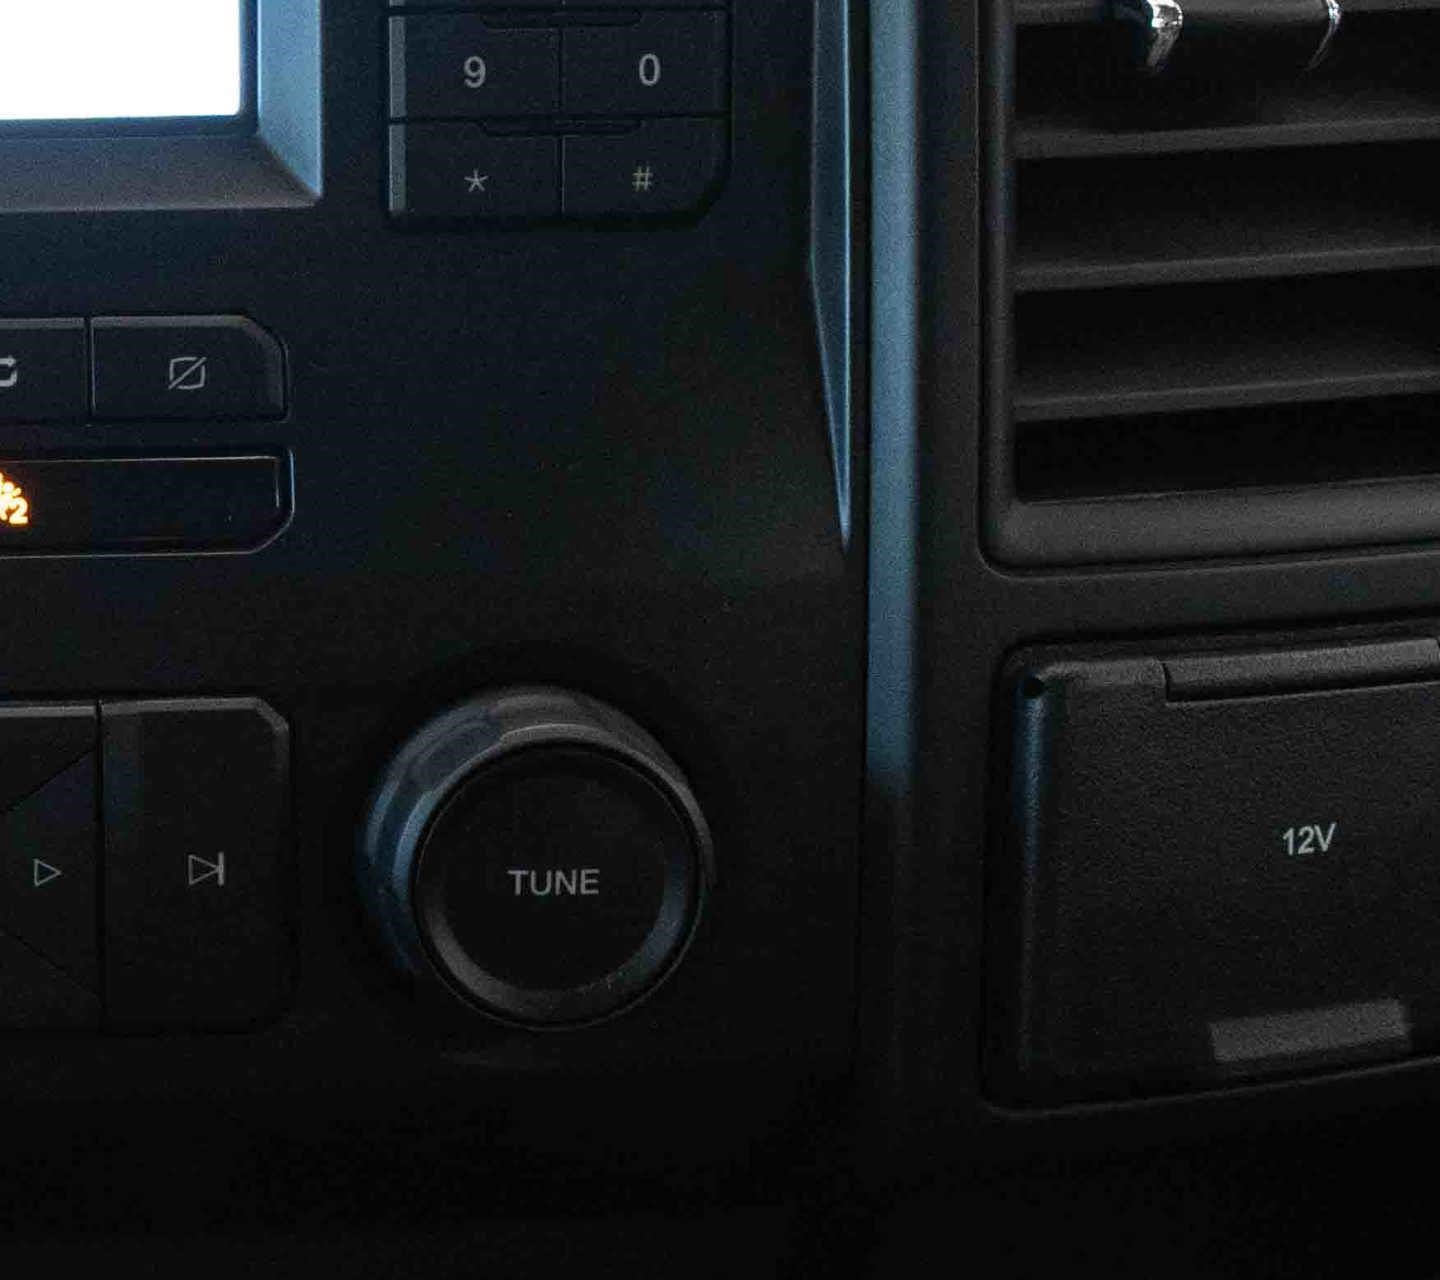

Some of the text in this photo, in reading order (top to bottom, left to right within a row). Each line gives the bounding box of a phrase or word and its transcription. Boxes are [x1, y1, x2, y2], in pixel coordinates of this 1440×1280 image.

[463, 55, 487, 88] 9
[638, 53, 661, 86] 0
[1281, 823, 1337, 856] 12V
[507, 868, 600, 897] TUNE
